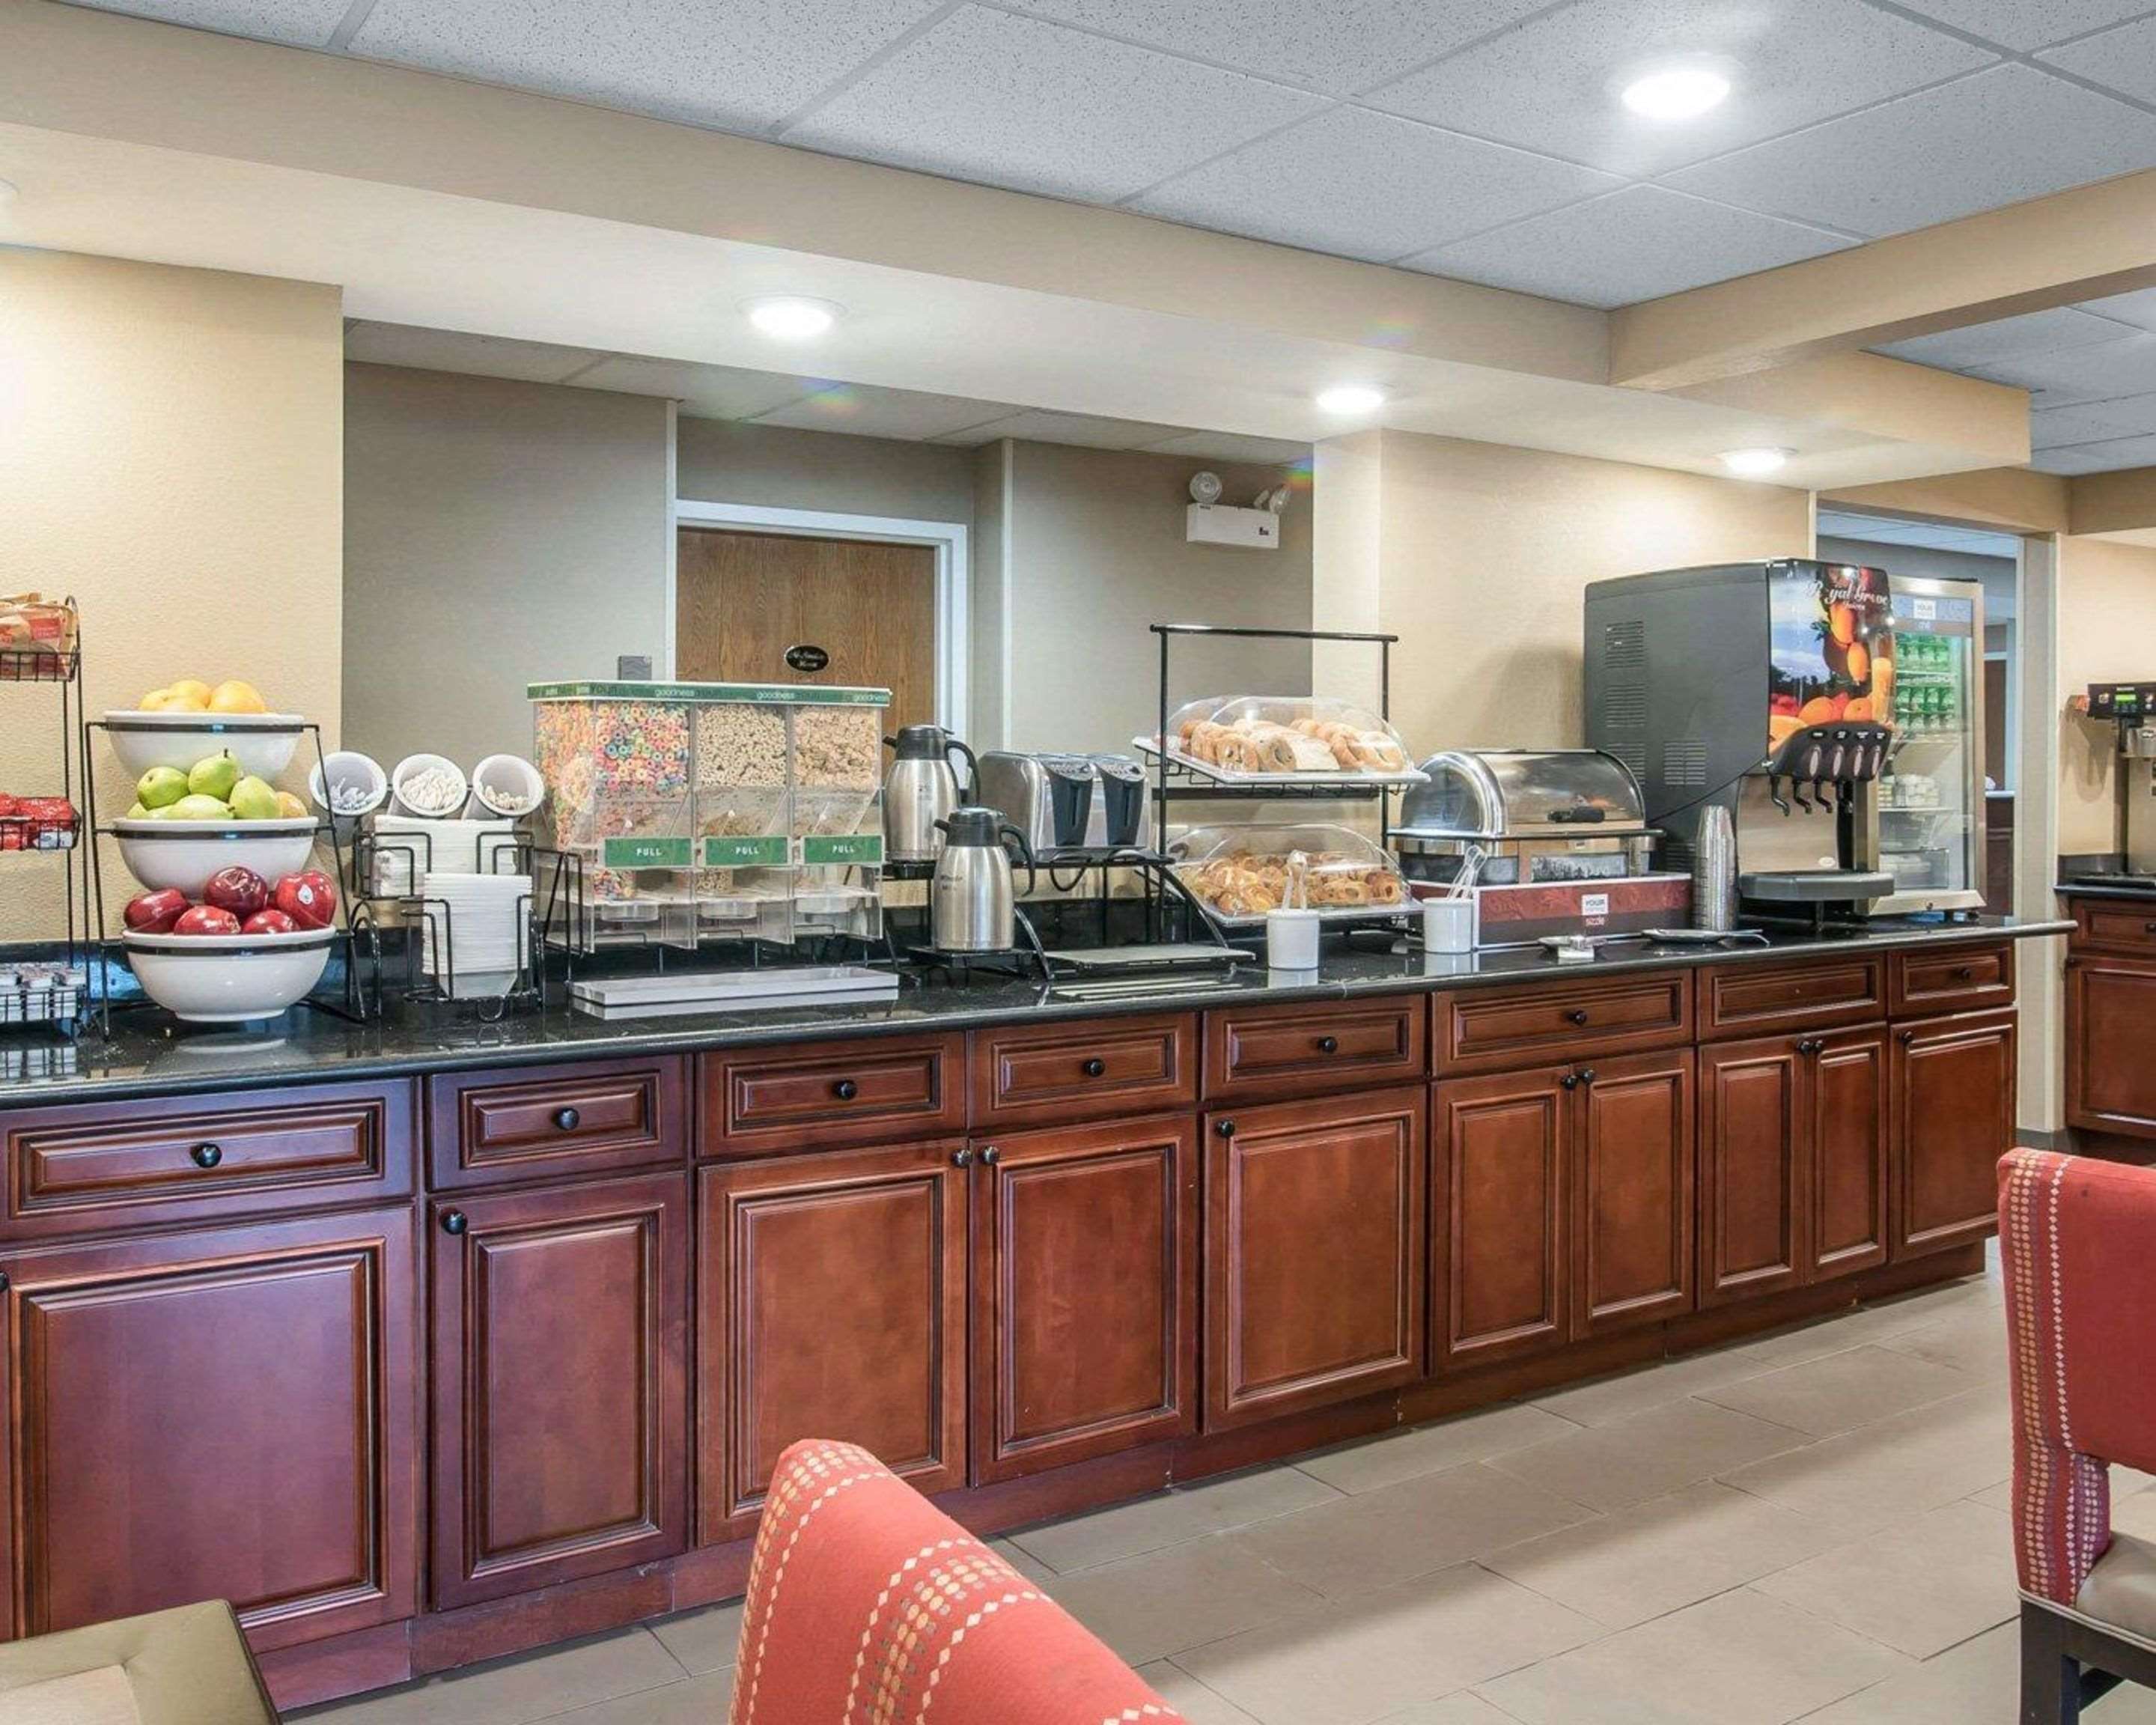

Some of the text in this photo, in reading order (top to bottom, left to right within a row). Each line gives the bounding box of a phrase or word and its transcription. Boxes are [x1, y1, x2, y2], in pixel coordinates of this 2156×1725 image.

[636, 848, 662, 857] PULL
[734, 846, 760, 856] PULL
[832, 844, 855, 854] PULL
